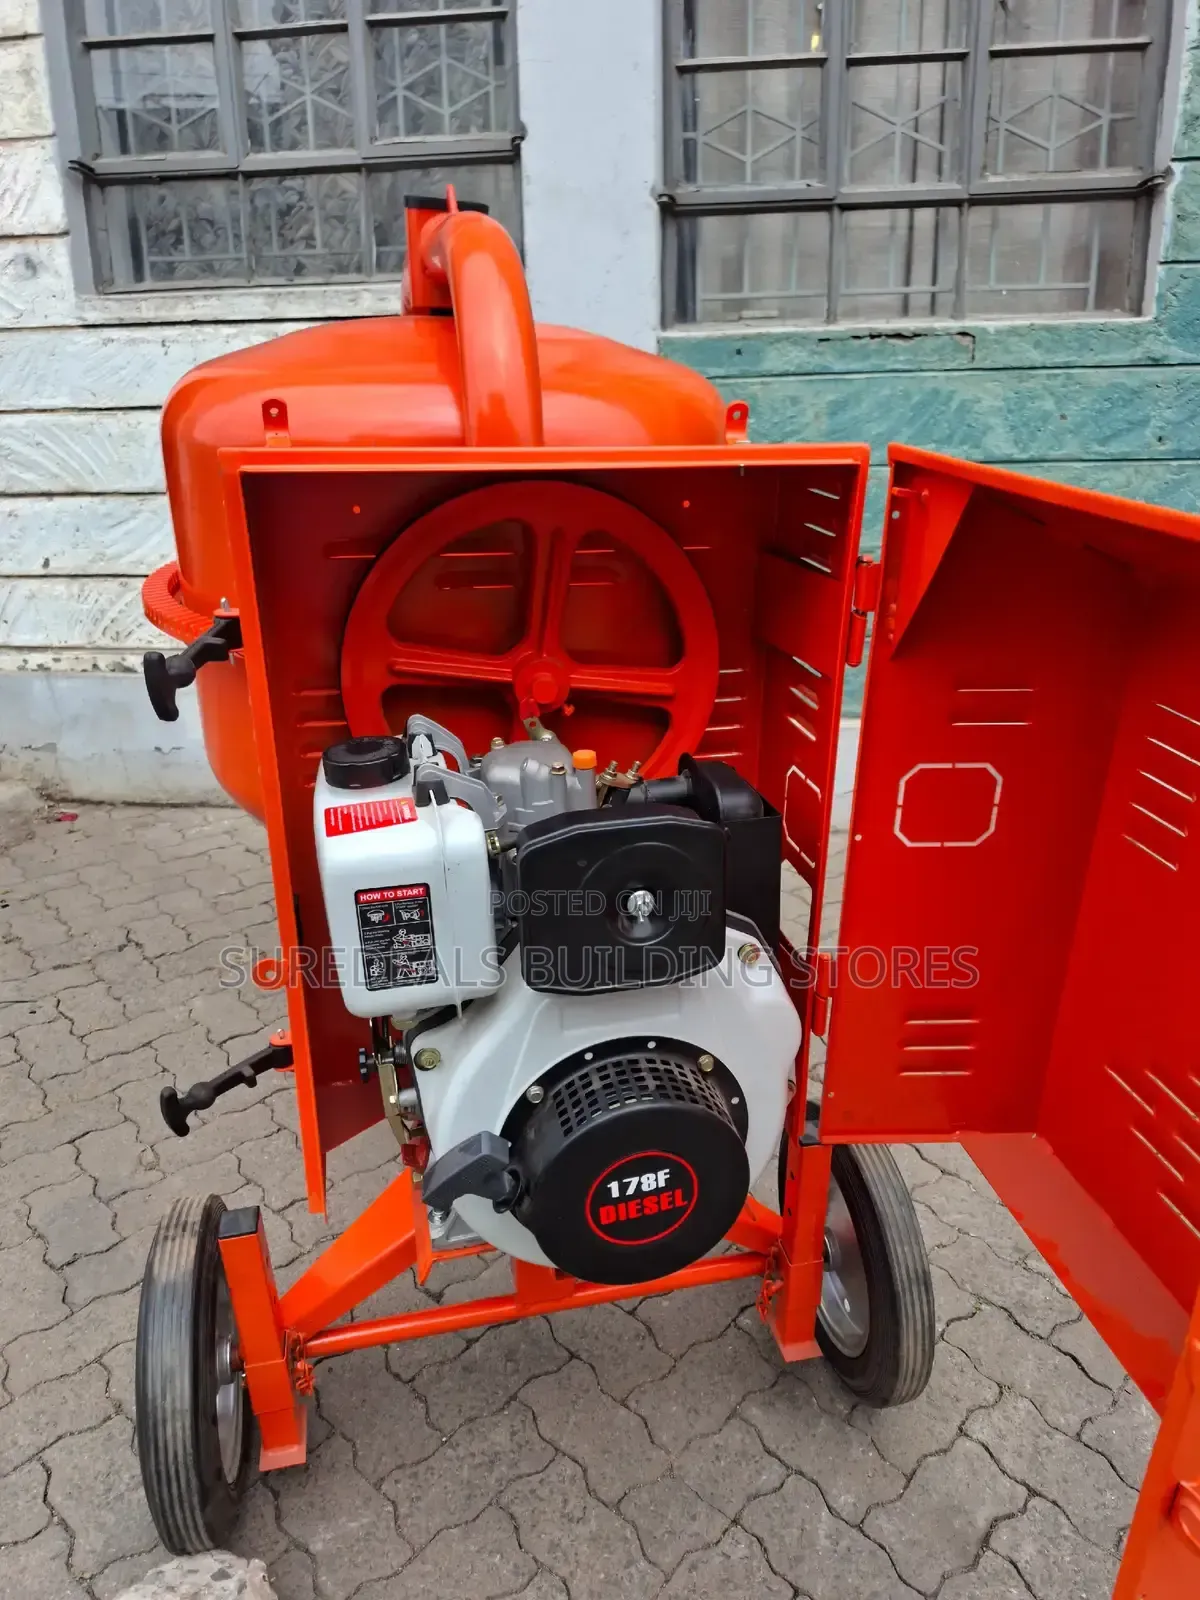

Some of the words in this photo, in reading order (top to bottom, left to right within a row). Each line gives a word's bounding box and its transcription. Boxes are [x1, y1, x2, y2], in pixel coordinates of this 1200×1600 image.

[360, 893, 381, 901] HOW
[397, 888, 424, 897] START
[607, 1168, 670, 1198] 178F
[599, 1188, 688, 1225] DIESEL
